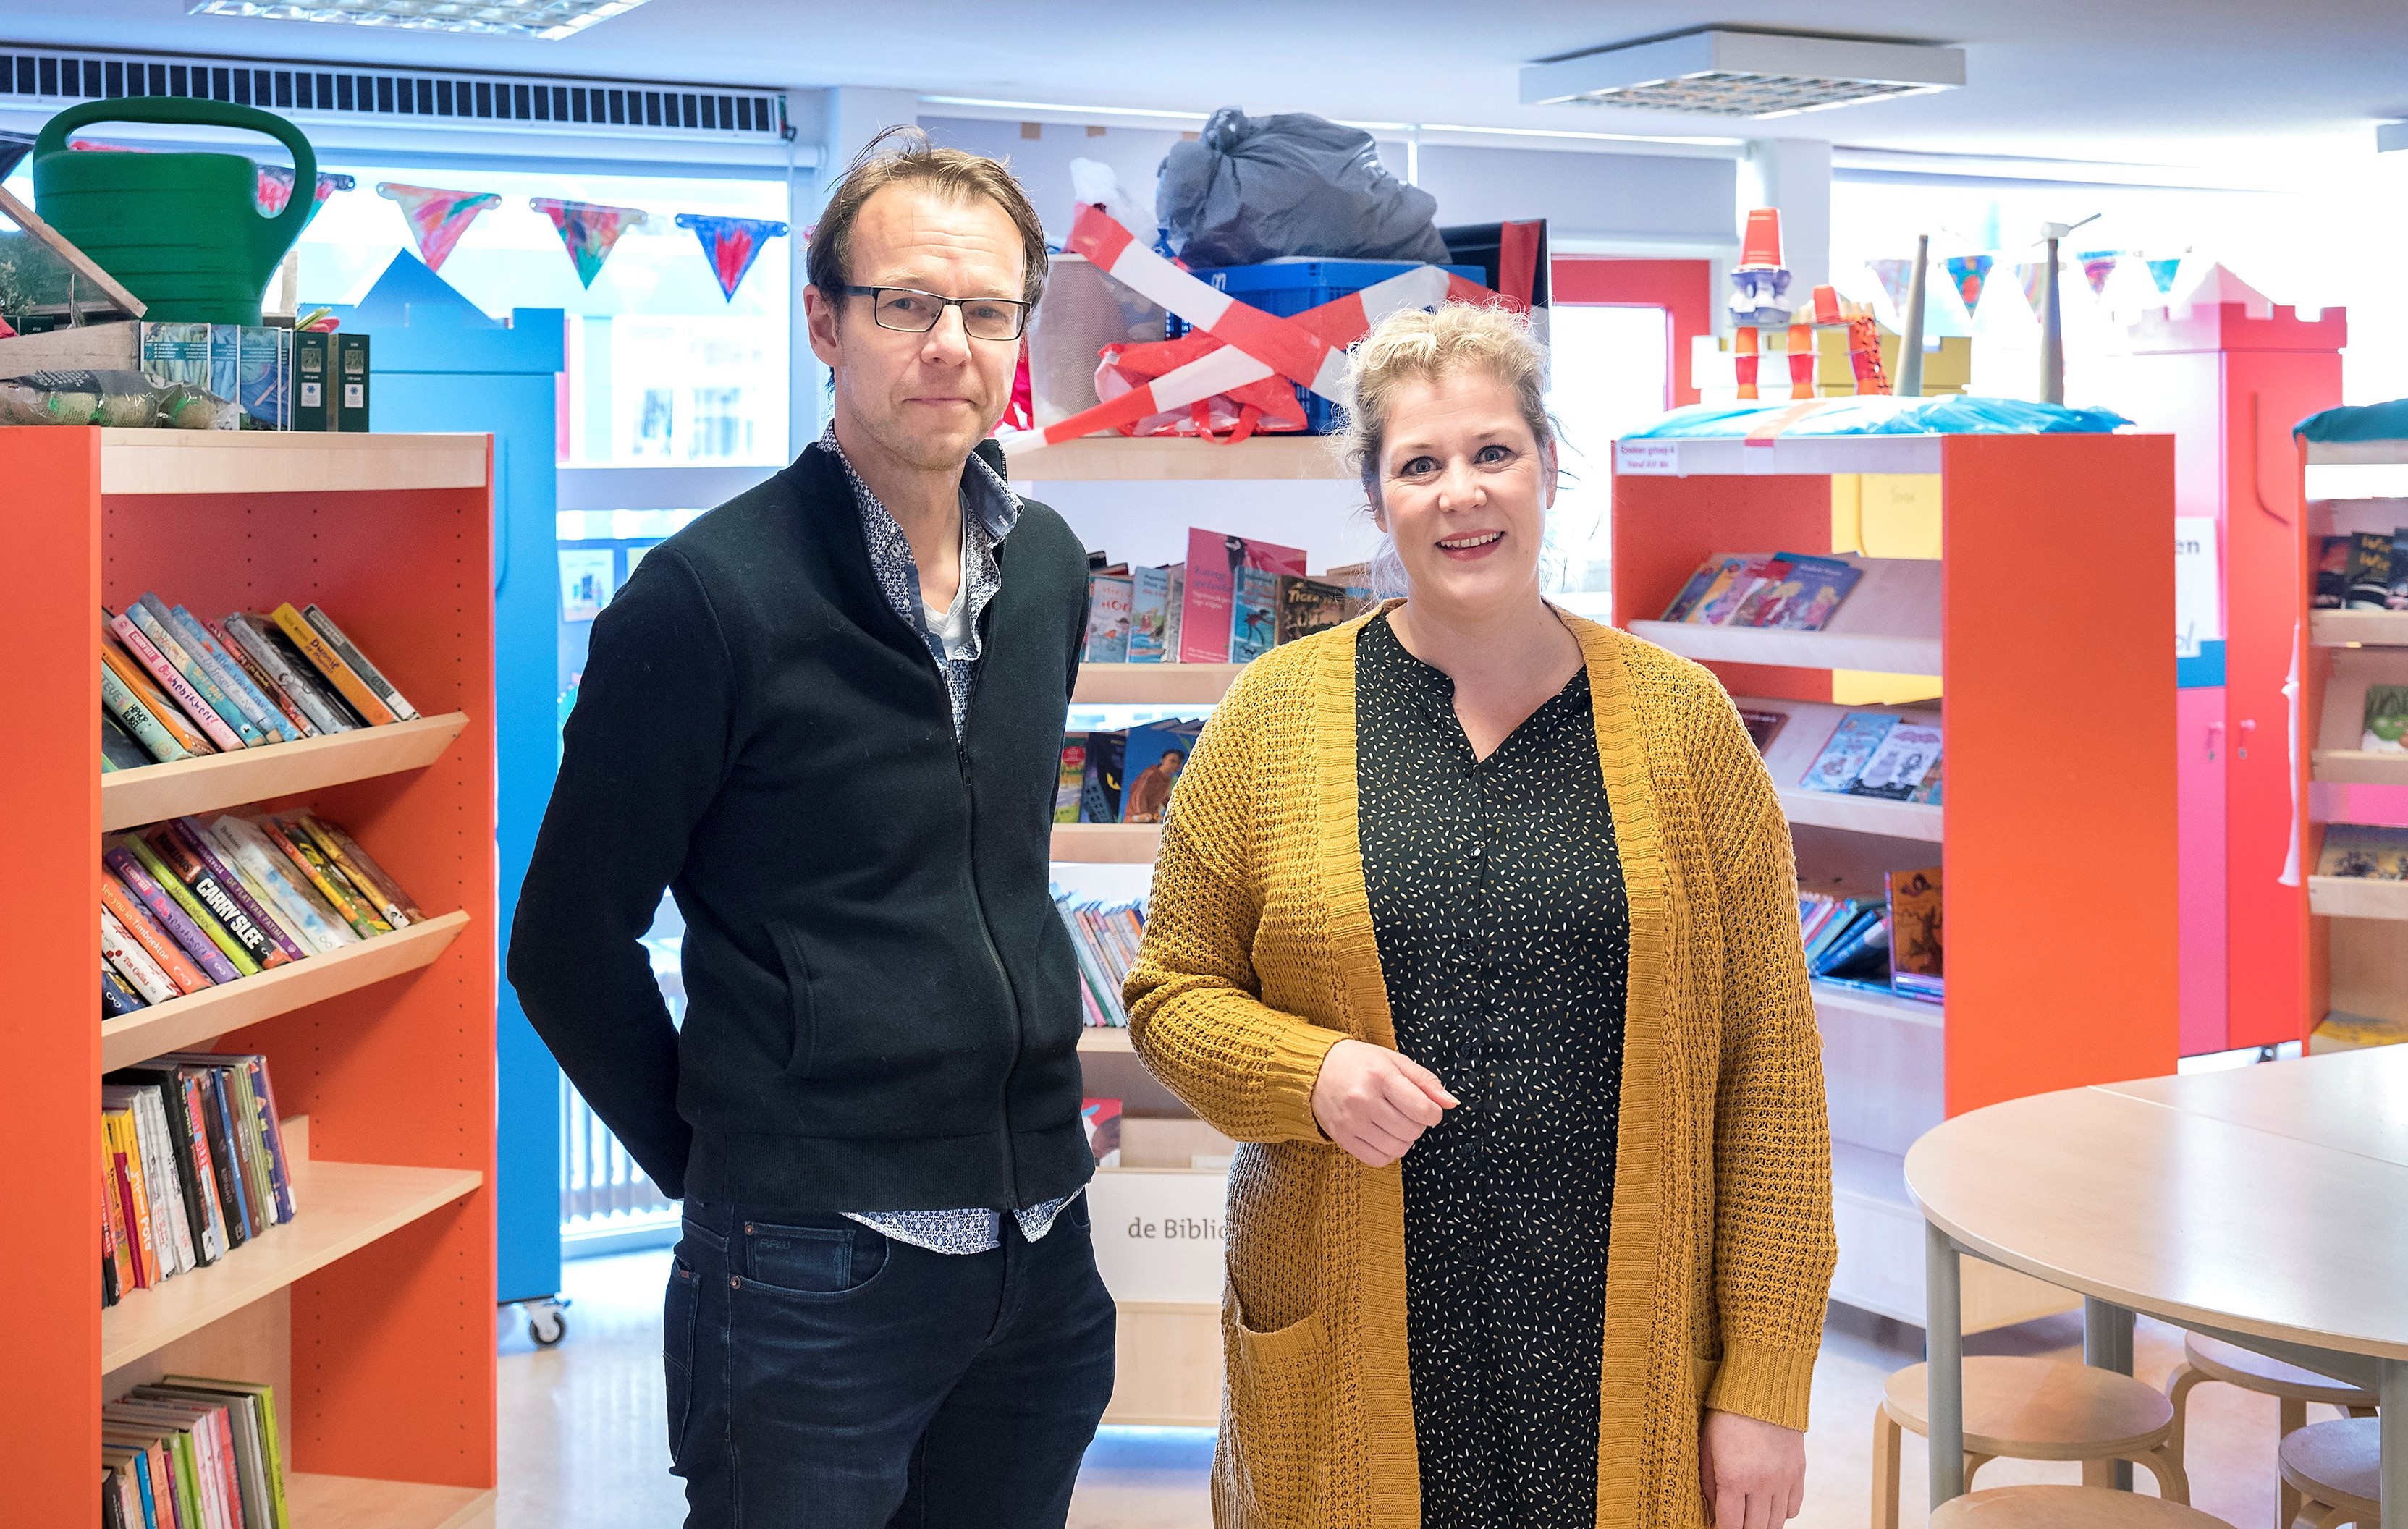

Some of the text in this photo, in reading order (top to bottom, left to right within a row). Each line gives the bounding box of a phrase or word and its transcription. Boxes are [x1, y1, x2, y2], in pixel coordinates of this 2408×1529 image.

[128, 703, 149, 724] HIPHOP
[100, 883, 172, 962] See you in Timboektoe
[195, 876, 265, 951] CARRY SLEE
[224, 876, 238, 889] DE
[234, 885, 252, 905] FLAT
[248, 901, 264, 918] VAN
[261, 915, 286, 942] FATIMA
[122, 956, 151, 986] Tim Collins
[1128, 1217, 1156, 1238] de
